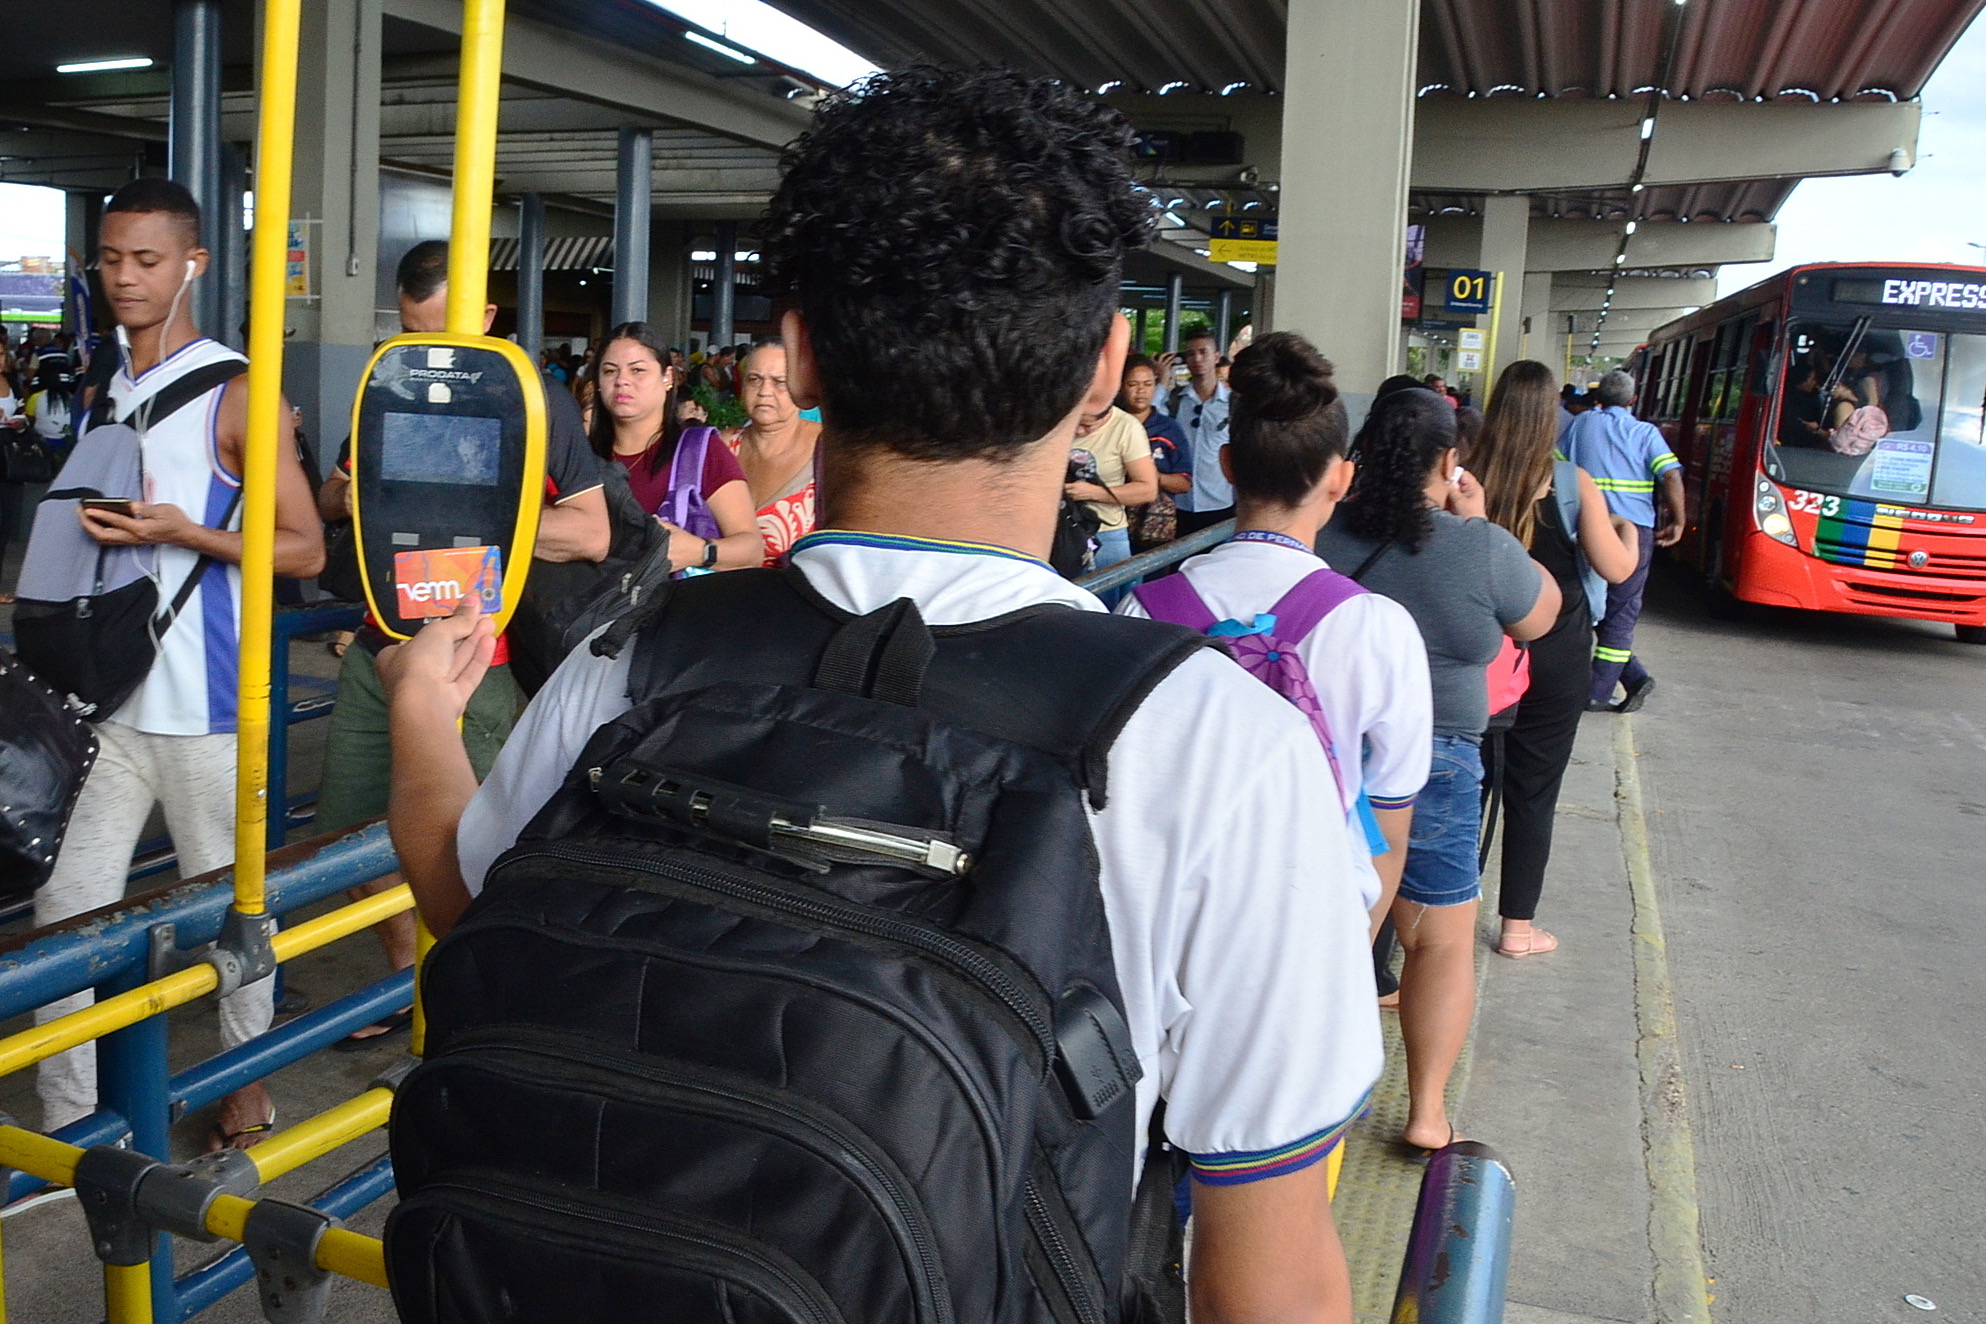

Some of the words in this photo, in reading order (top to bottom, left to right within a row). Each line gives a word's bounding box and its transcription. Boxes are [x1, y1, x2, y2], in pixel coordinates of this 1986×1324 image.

[1453, 275, 1485, 300] 01
[410, 369, 471, 379] PRODATA
[1789, 489, 1841, 517] 323
[396, 580, 466, 602] vem
